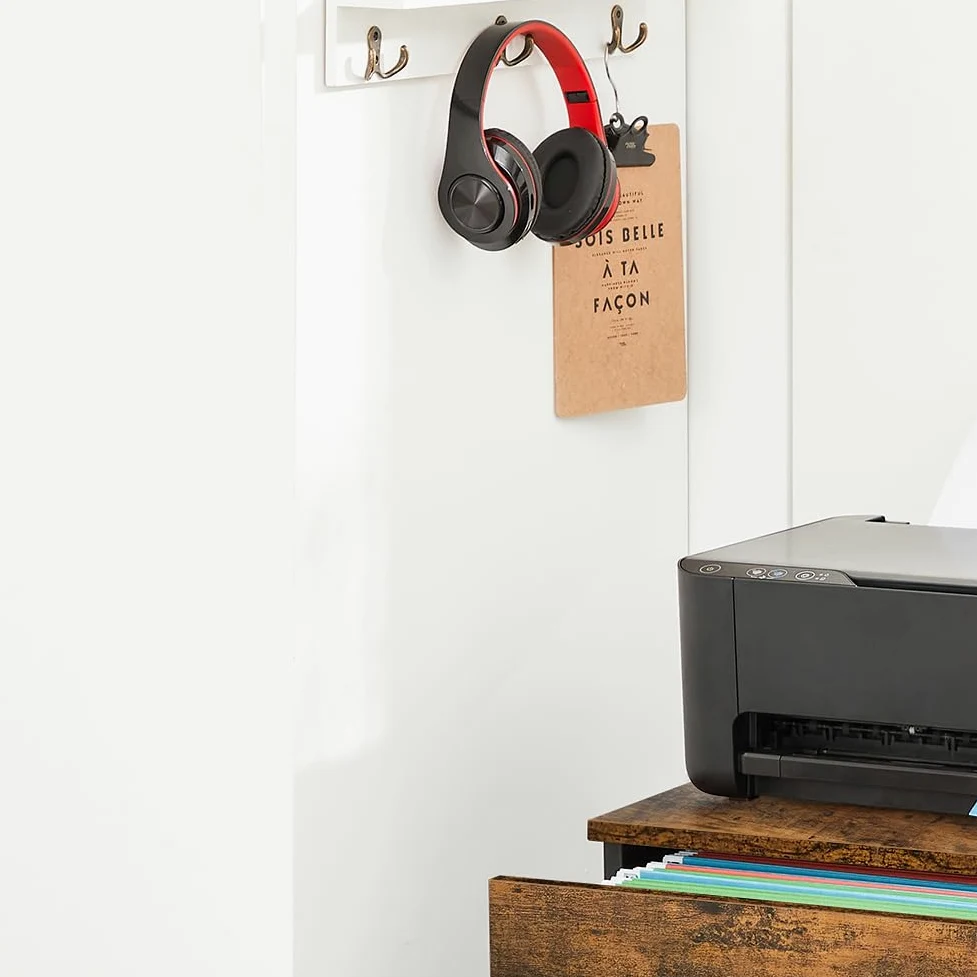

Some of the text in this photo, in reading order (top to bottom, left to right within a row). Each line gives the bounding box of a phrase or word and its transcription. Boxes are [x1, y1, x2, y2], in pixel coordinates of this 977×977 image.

[622, 223, 664, 243] BELLE
[602, 259, 639, 279] À TA
[593, 290, 650, 315] FAÇON
